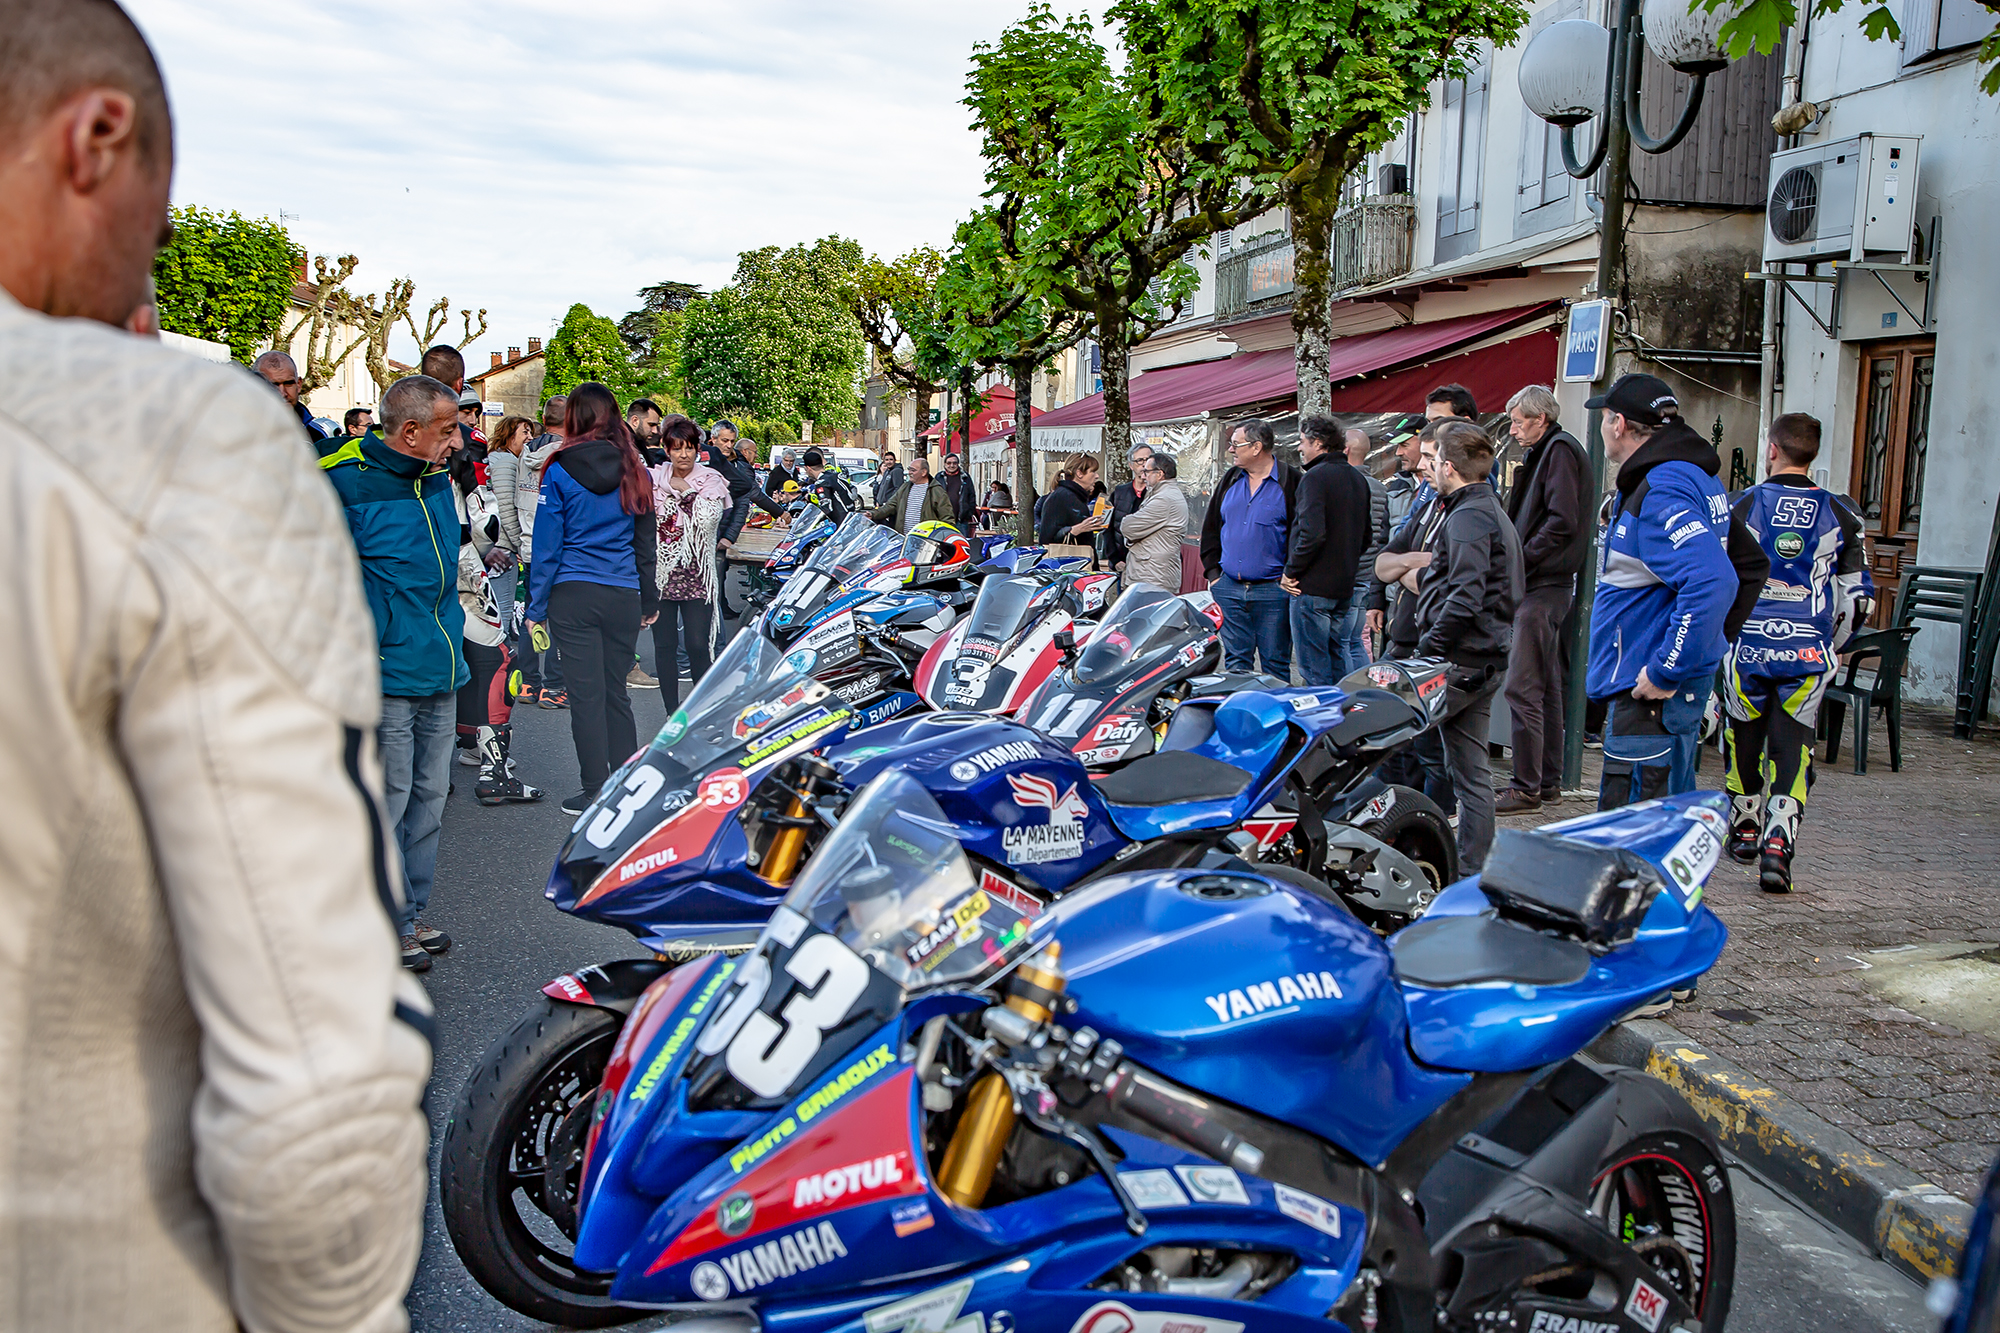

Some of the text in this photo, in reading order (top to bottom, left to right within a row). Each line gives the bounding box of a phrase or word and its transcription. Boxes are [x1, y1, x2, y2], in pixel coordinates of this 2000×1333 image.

[1571, 330, 1598, 354] TAXIS
[1771, 496, 1819, 529] 53
[984, 653, 997, 661] 111
[1663, 649, 1679, 671] TEAM
[944, 657, 991, 699] 3
[868, 697, 901, 724] BMW
[944, 695, 978, 707] DUCATI
[1032, 692, 1103, 739] 11
[738, 707, 850, 768] Valentin GRIMOUX
[1093, 721, 1145, 744] Dafy
[972, 741, 1042, 772] YAMAHA
[706, 781, 741, 806] 53
[1005, 823, 1084, 847] LA MAYENNE
[620, 847, 678, 881] MOTUL
[1010, 845, 1081, 862] Le Département
[907, 917, 957, 962] TEAM
[555, 976, 584, 999] OTUL
[1206, 971, 1343, 1023] YAMAHA
[728, 1043, 898, 1173] Pierre GRIMOUX
[792, 1155, 904, 1208] MOTUL
[721, 1220, 849, 1292] YAMAHA
[1633, 1284, 1663, 1319] RK
[1532, 1310, 1620, 1333] FRANCE
